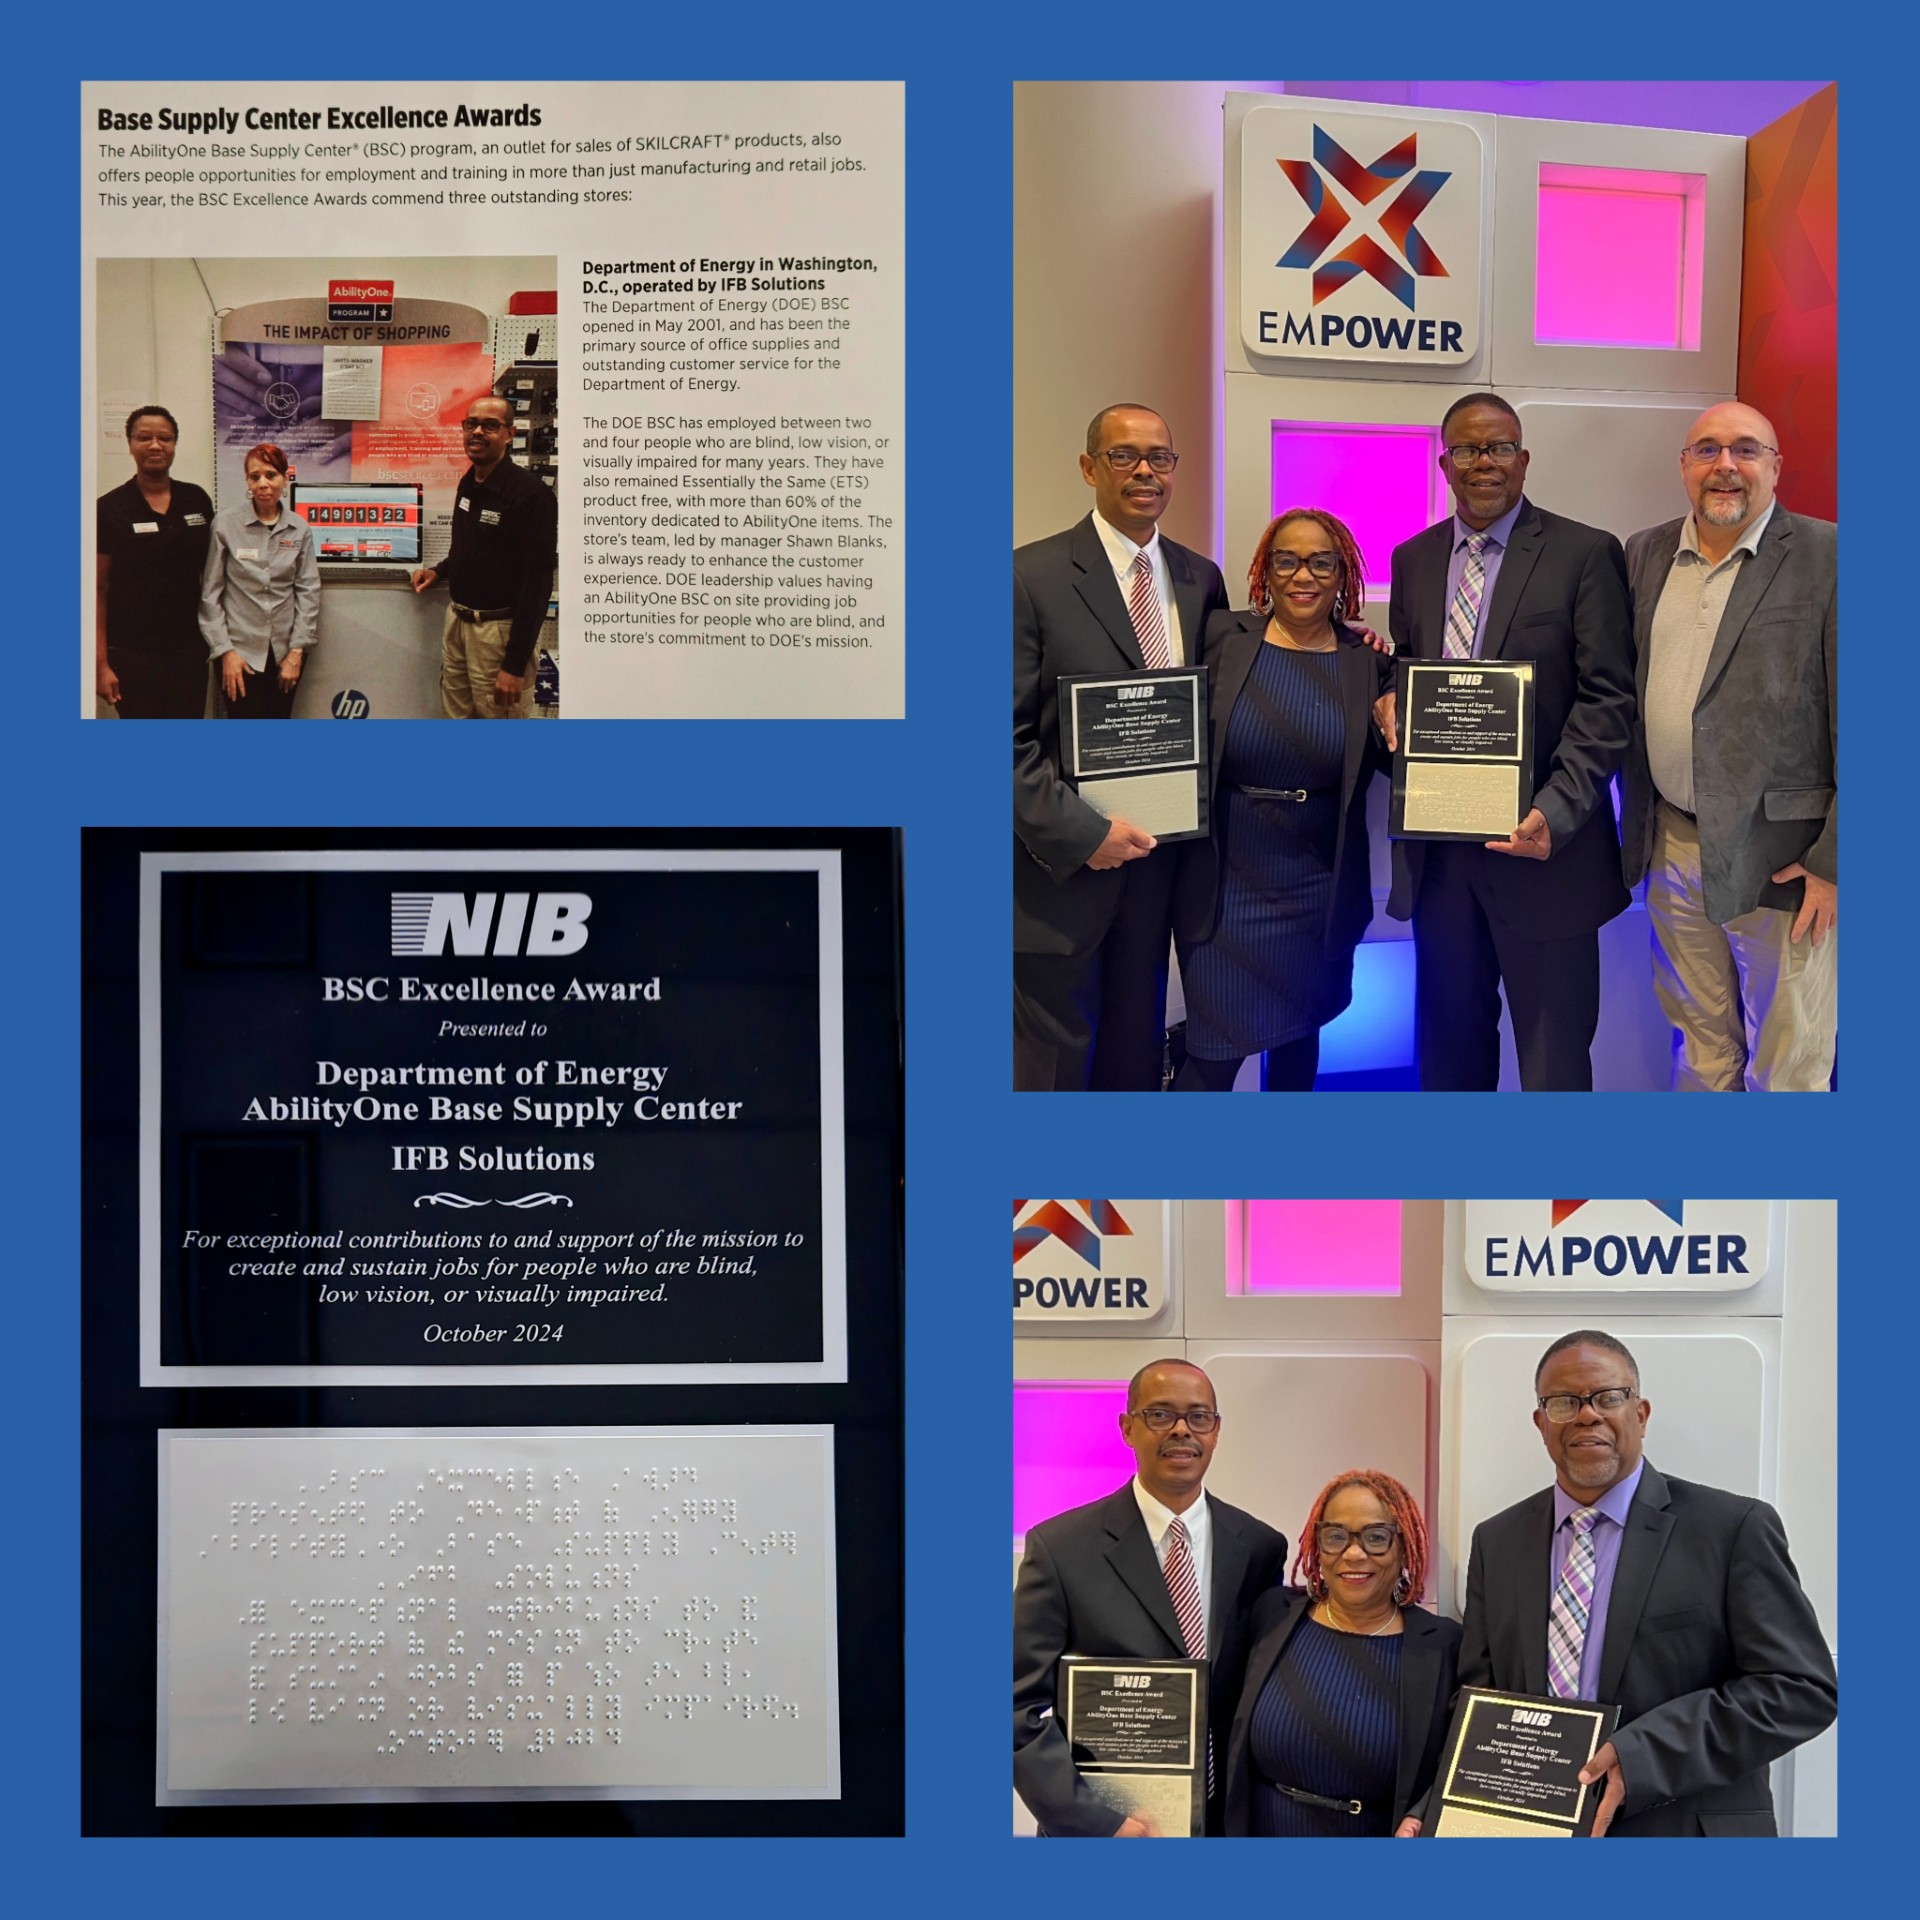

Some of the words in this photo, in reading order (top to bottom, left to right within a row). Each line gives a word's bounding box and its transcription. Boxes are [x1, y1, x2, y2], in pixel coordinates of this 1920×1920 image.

[97, 108, 153, 131] Base
[157, 107, 240, 135] Supply
[245, 107, 322, 131] Center
[327, 105, 449, 130] Excellence
[453, 103, 542, 128] Awards
[98, 144, 125, 158] The
[129, 143, 207, 160] AbilityOne
[211, 143, 246, 157] Base
[250, 143, 300, 160] Supply
[363, 142, 406, 159] (BSC)
[410, 143, 477, 158] program,
[481, 143, 499, 155] an
[503, 140, 546, 155] outlet
[550, 139, 572, 154] for
[575, 138, 612, 153] sales
[616, 137, 632, 152] of
[735, 133, 807, 151] products,
[811, 131, 842, 146] also
[98, 168, 141, 183] offers
[145, 168, 195, 185] people
[198, 167, 297, 185] opportunities
[300, 167, 321, 182] for
[325, 167, 416, 184] employment
[420, 165, 448, 181] and
[451, 165, 508, 182] training
[512, 165, 525, 179] in
[529, 167, 568, 179] more
[571, 163, 605, 178] than
[608, 162, 636, 180] just
[641, 159, 751, 176] manufacturing
[755, 157, 785, 173] and
[789, 157, 827, 172] retail
[830, 157, 867, 174] jobs.
[97, 192, 128, 207] This
[131, 195, 166, 209] year,
[170, 192, 195, 207] the
[199, 192, 229, 207] BSC
[233, 192, 309, 206] Excellence
[313, 191, 368, 206] Awards
[371, 190, 444, 205] commend
[448, 189, 487, 205] three
[490, 188, 579, 205] outstanding
[583, 189, 633, 203] stores:
[583, 259, 676, 277] Department
[679, 258, 696, 273] of
[699, 258, 756, 274] Energy
[759, 257, 774, 271] in
[777, 256, 877, 273] Washington,
[334, 286, 390, 299] AbilityOne
[583, 279, 619, 297] D.C.,
[622, 277, 694, 296] operated
[697, 277, 717, 295] by
[721, 277, 747, 292] IFB
[751, 276, 825, 291] Solutions
[332, 309, 370, 317] PROGRAM
[582, 300, 608, 314] The
[612, 299, 695, 315] Department
[699, 298, 714, 312] of
[718, 298, 768, 313] Energy
[771, 297, 816, 313] (DOE)
[821, 297, 849, 310] BSC
[263, 323, 291, 339] THE
[294, 324, 348, 341] IMPACT
[352, 326, 374, 341] OF
[376, 324, 451, 340] SHOPPING
[582, 319, 635, 335] opened
[638, 319, 651, 333] in
[655, 319, 683, 334] May
[687, 318, 725, 333] 2001,
[729, 317, 756, 331] and
[759, 317, 785, 331] has
[788, 317, 823, 331] been
[827, 317, 851, 330] the
[1259, 310, 1464, 353] EMPOWER
[582, 339, 637, 355] primary
[639, 341, 687, 352] source
[690, 337, 705, 351] of
[707, 337, 748, 351] office
[751, 337, 810, 353] supplies
[813, 336, 840, 350] and
[582, 357, 666, 373] outstanding
[669, 358, 736, 371] customer
[739, 357, 790, 371] service
[793, 356, 814, 370] for
[817, 356, 841, 370] the
[1452, 673, 1483, 686] NIB
[1120, 685, 1155, 700] NIB
[336, 690, 367, 718] hp
[408, 892, 593, 956] NIB
[322, 977, 389, 1002] BSC
[399, 977, 556, 1002] Excellence
[562, 976, 662, 1001] Award
[438, 1019, 527, 1037] Presented
[530, 1022, 548, 1037] to
[316, 1061, 507, 1092] Department
[515, 1060, 549, 1086] of
[555, 1060, 669, 1092] Energy
[241, 1096, 419, 1128] AbilityOne
[428, 1096, 503, 1121] Base
[513, 1095, 625, 1128] Supply
[633, 1095, 743, 1121] Center
[391, 1145, 449, 1171] IFB
[458, 1145, 595, 1171] Solutions
[182, 1230, 221, 1249] For
[226, 1229, 344, 1254] exceptional
[348, 1229, 483, 1249] contributions
[488, 1232, 508, 1249] to
[513, 1229, 553, 1249] and
[556, 1232, 635, 1253] support
[639, 1228, 666, 1253] of
[665, 1229, 697, 1247] the
[701, 1229, 779, 1248] mission
[783, 1231, 804, 1247] to
[1486, 1233, 1750, 1278] EMPOWER
[228, 1260, 297, 1276] create
[302, 1257, 346, 1276] and
[349, 1258, 427, 1276] sustain
[428, 1256, 480, 1281] jobs
[480, 1256, 519, 1281] for
[521, 1256, 597, 1281] people
[603, 1255, 649, 1275] who
[654, 1261, 691, 1275] are
[696, 1255, 757, 1277] blind,
[318, 1283, 359, 1303] low
[365, 1285, 435, 1306] vision,
[443, 1289, 470, 1303] or
[474, 1283, 561, 1308] visually
[566, 1282, 669, 1308] impaired.
[423, 1323, 508, 1343] October
[512, 1323, 565, 1343] 2024
[1117, 1675, 1152, 1689] NIB
[1514, 1709, 1552, 1727] NIB
